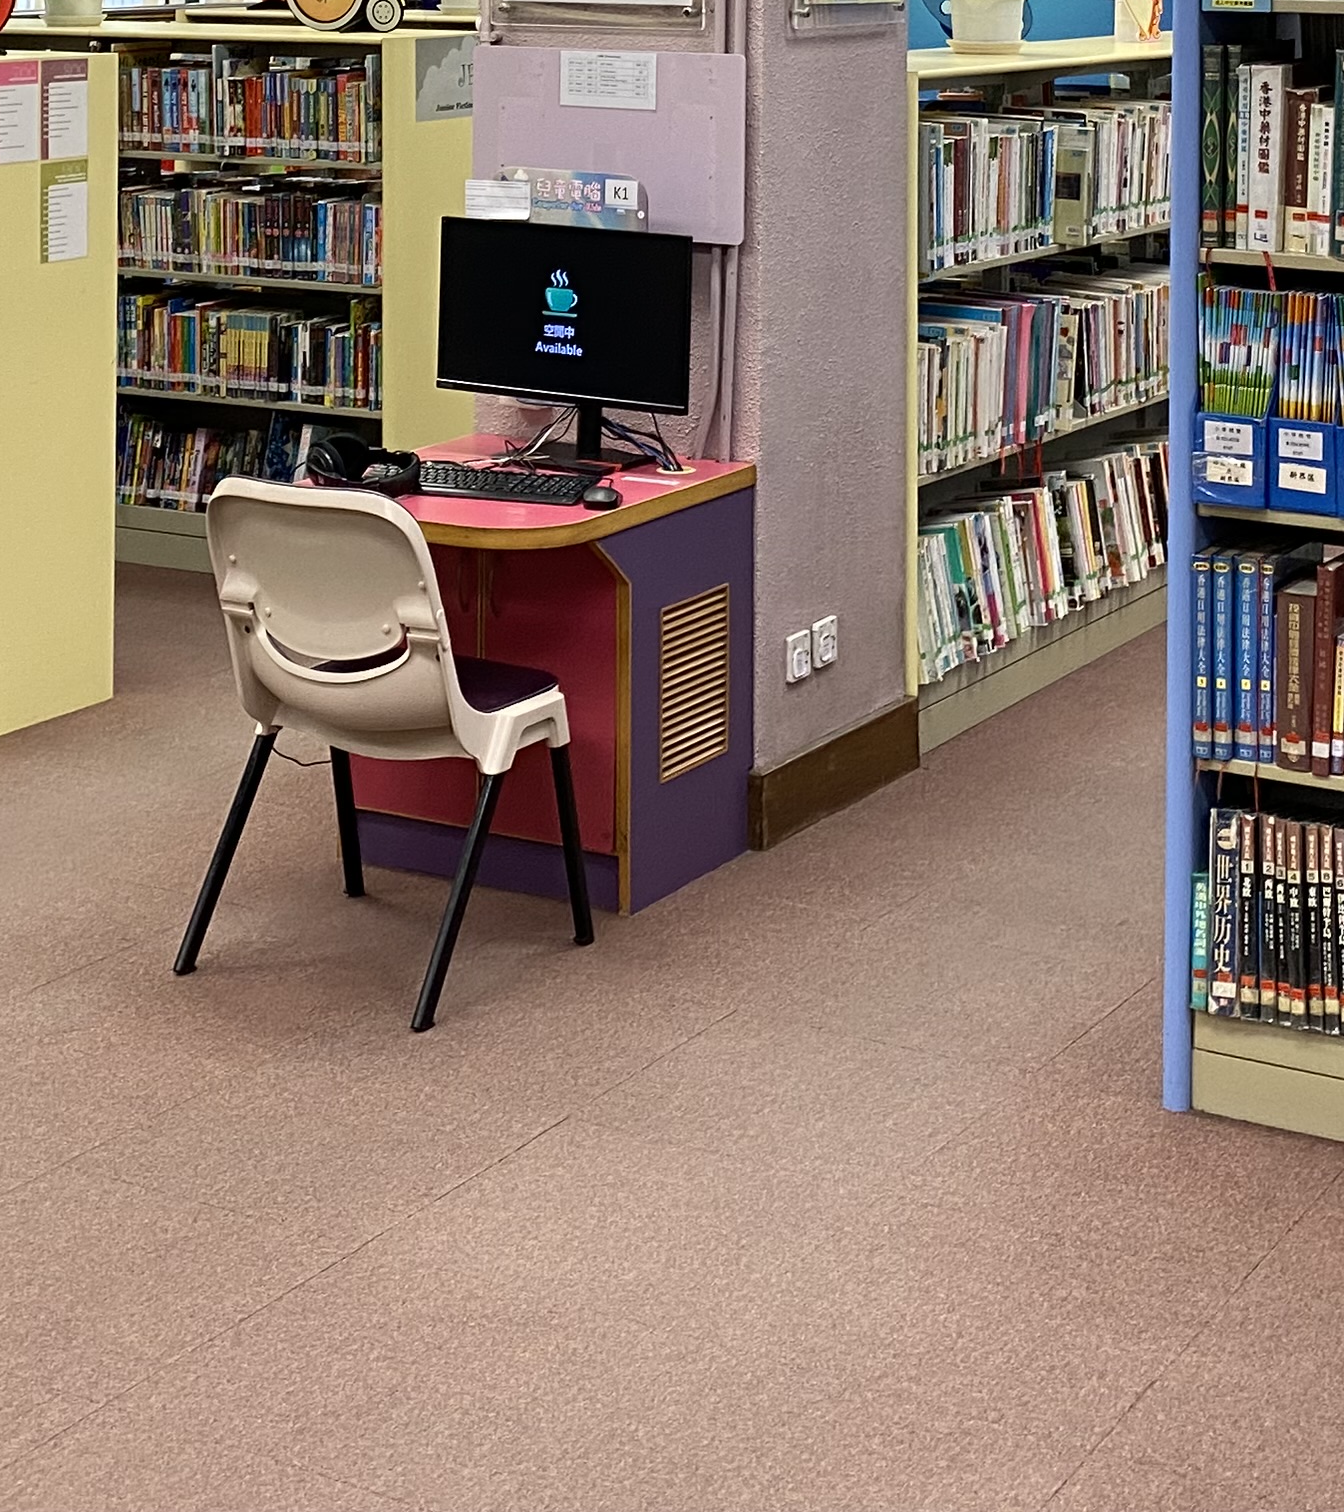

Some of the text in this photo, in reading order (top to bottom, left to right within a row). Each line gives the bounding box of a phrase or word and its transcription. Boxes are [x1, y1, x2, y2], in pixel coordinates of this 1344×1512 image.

[613, 187, 629, 200] K1
[535, 341, 583, 356] Available
[1214, 854, 1234, 974] 世界历史
